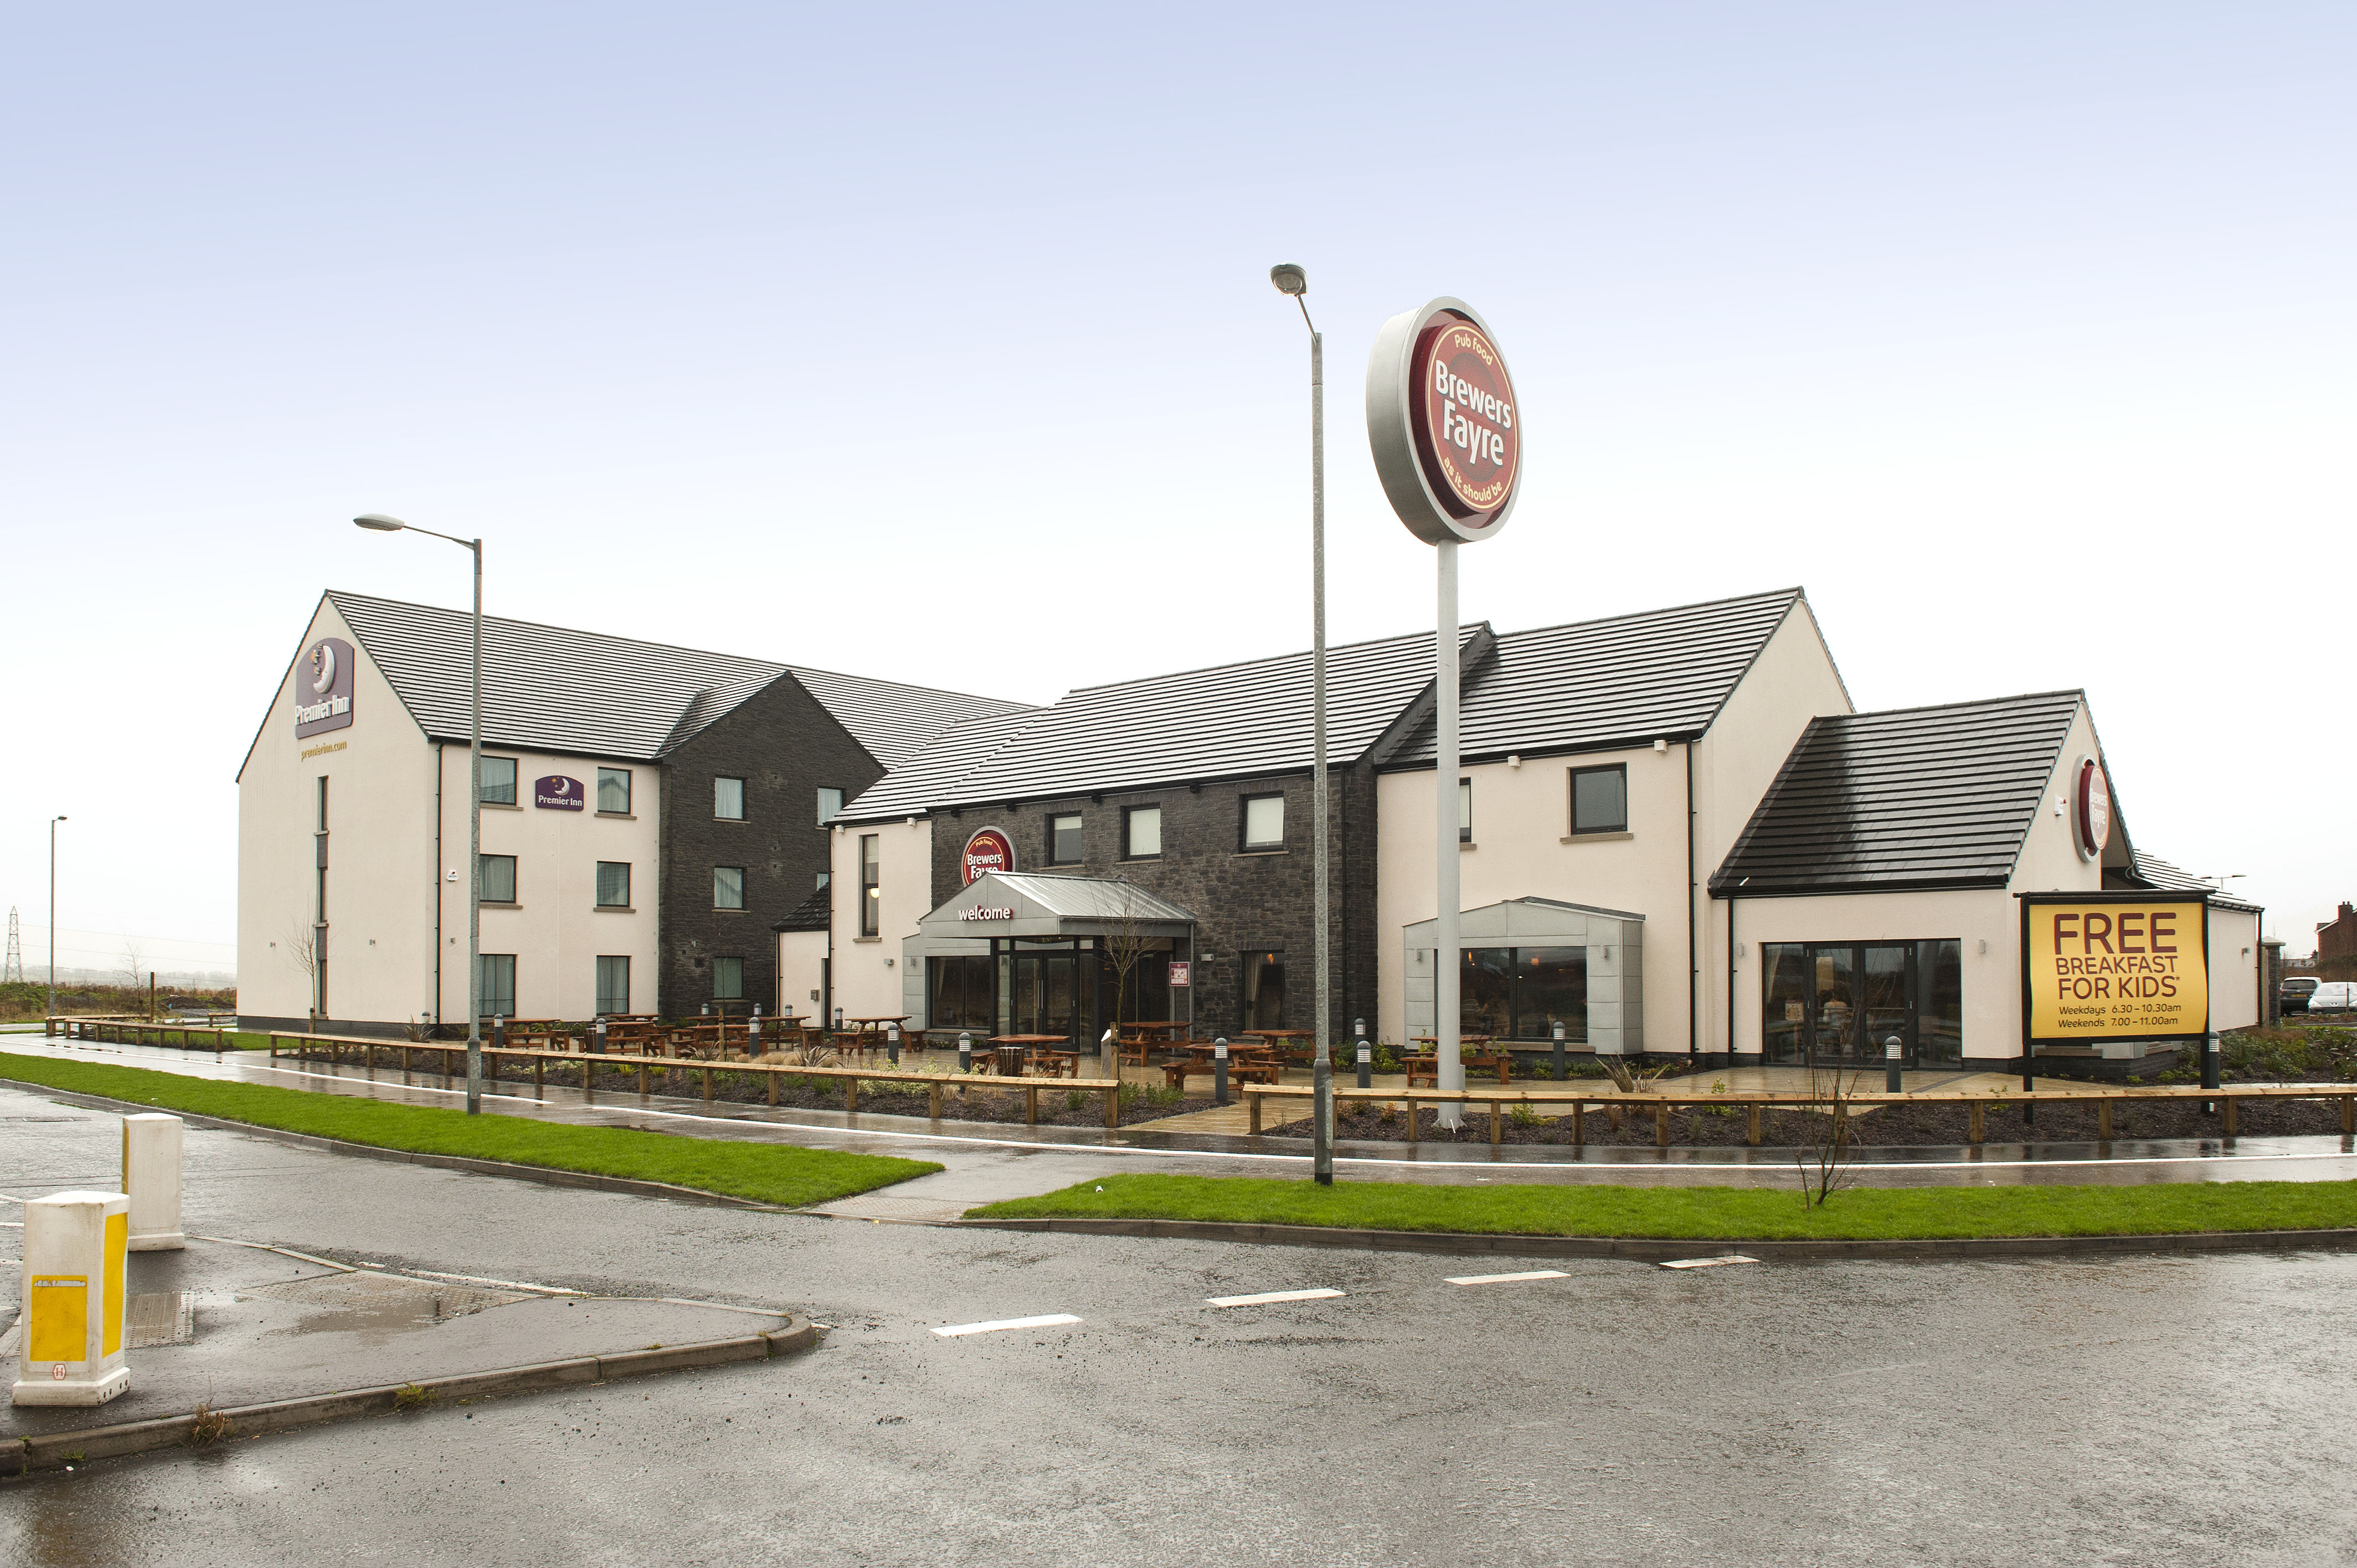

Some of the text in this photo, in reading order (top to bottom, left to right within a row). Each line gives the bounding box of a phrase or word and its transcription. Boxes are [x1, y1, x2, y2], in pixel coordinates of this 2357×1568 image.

[1454, 333, 1493, 365] Pub food
[1435, 360, 1512, 429] Brewers
[1444, 399, 1504, 466] Fayre
[1444, 457, 1502, 502] as it should be
[295, 695, 349, 725] Premier Inn
[301, 741, 347, 762] premierinn.com
[538, 795, 583, 807] Premier Inn
[967, 854, 1002, 865] Brewers
[958, 905, 1011, 920] welcome
[2054, 912, 2178, 955] FREE
[2056, 956, 2178, 975] BREAKFAST
[2058, 977, 2110, 1000] FOR
[2059, 1005, 2106, 1016] Weekdays
[2112, 1004, 2132, 1013] 6.30
[2142, 1004, 2181, 1013] 10.30am
[2058, 1018, 2105, 1028] Weekends
[2111, 1017, 2130, 1026] 7.00
[2139, 1017, 2178, 1025] 11.00am
[56, 1367, 63, 1376] H
